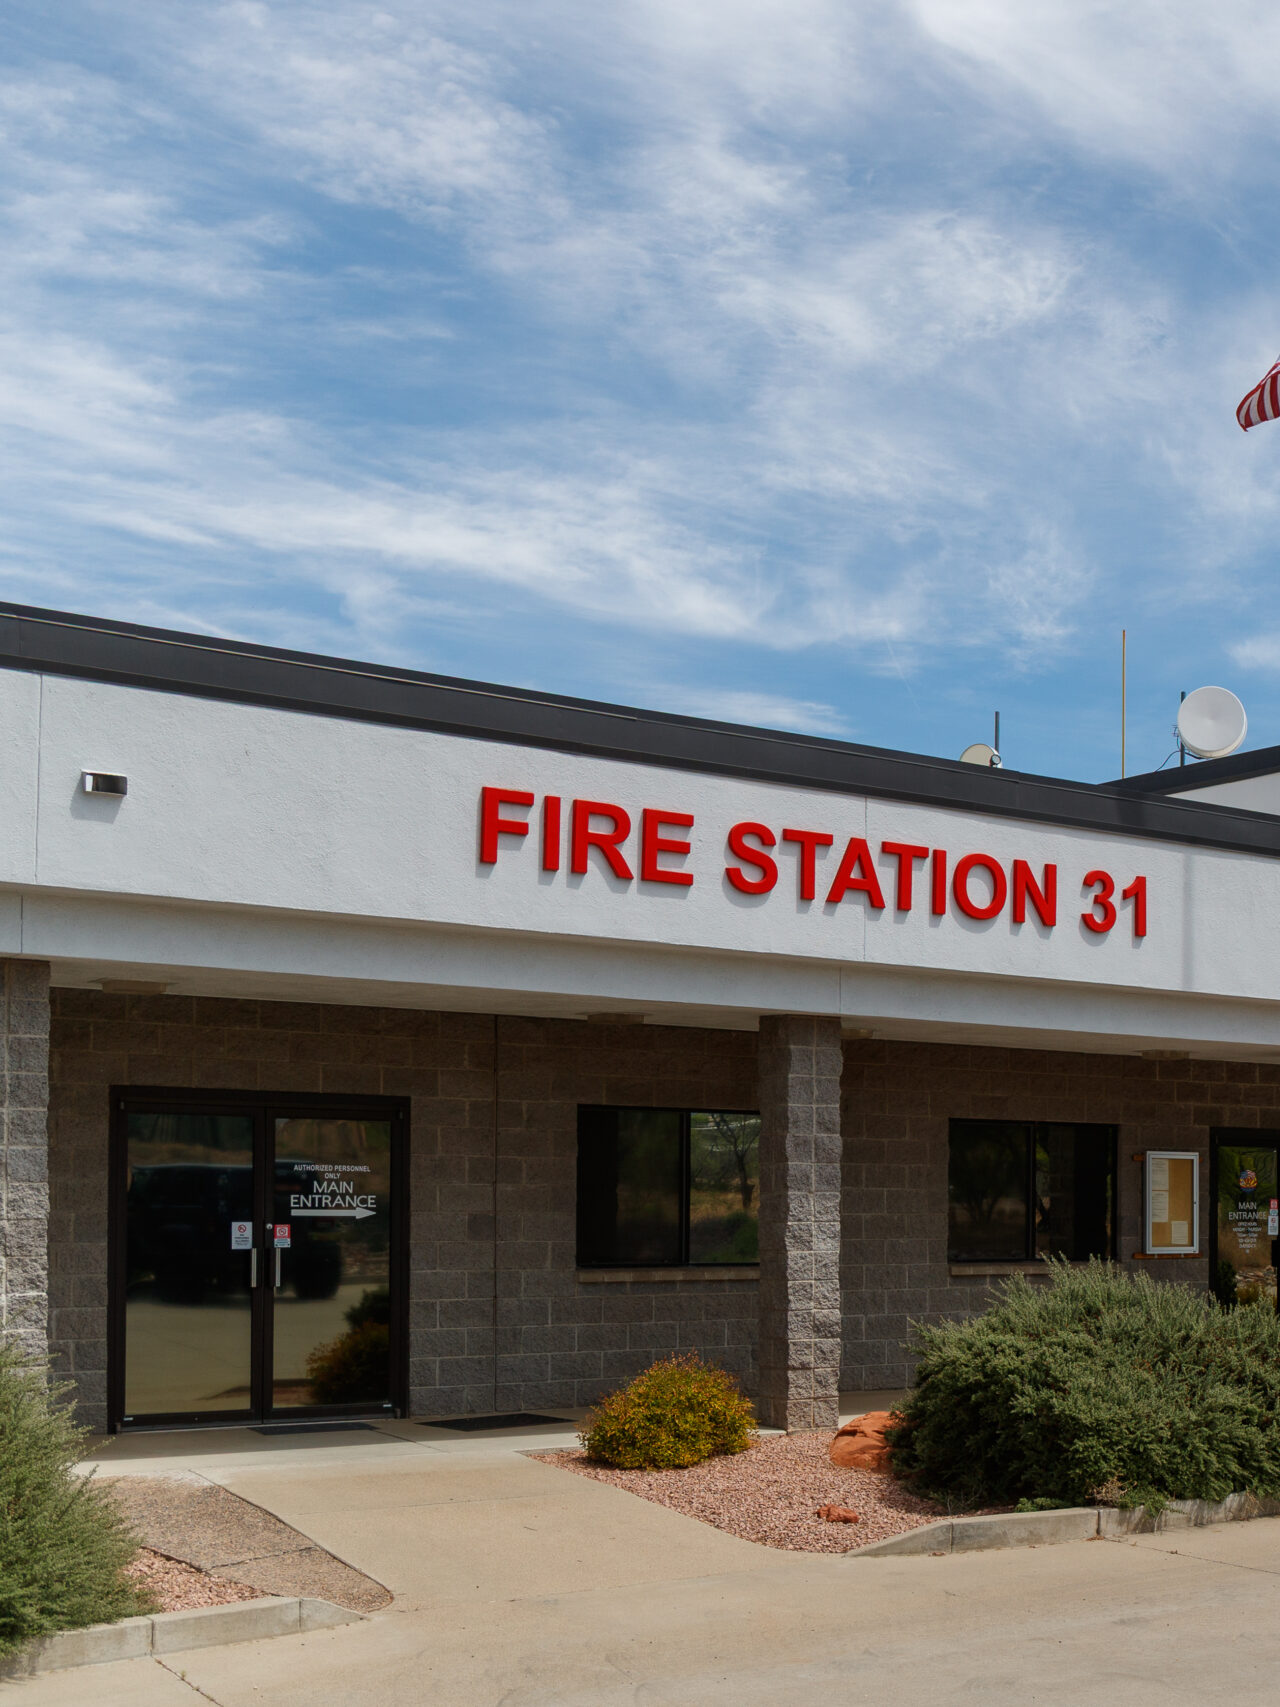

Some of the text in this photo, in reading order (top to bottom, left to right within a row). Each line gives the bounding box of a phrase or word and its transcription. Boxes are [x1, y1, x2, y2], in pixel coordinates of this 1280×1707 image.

[480, 786, 1147, 937] FIRE STATION 31
[293, 1164, 371, 1173] AUTHORIZED PERSONNEL
[313, 1180, 353, 1194] MAIN
[290, 1194, 377, 1208] ENTRANCE
[1238, 1201, 1257, 1210] MAIN
[1228, 1211, 1267, 1220] ENTRANCE
